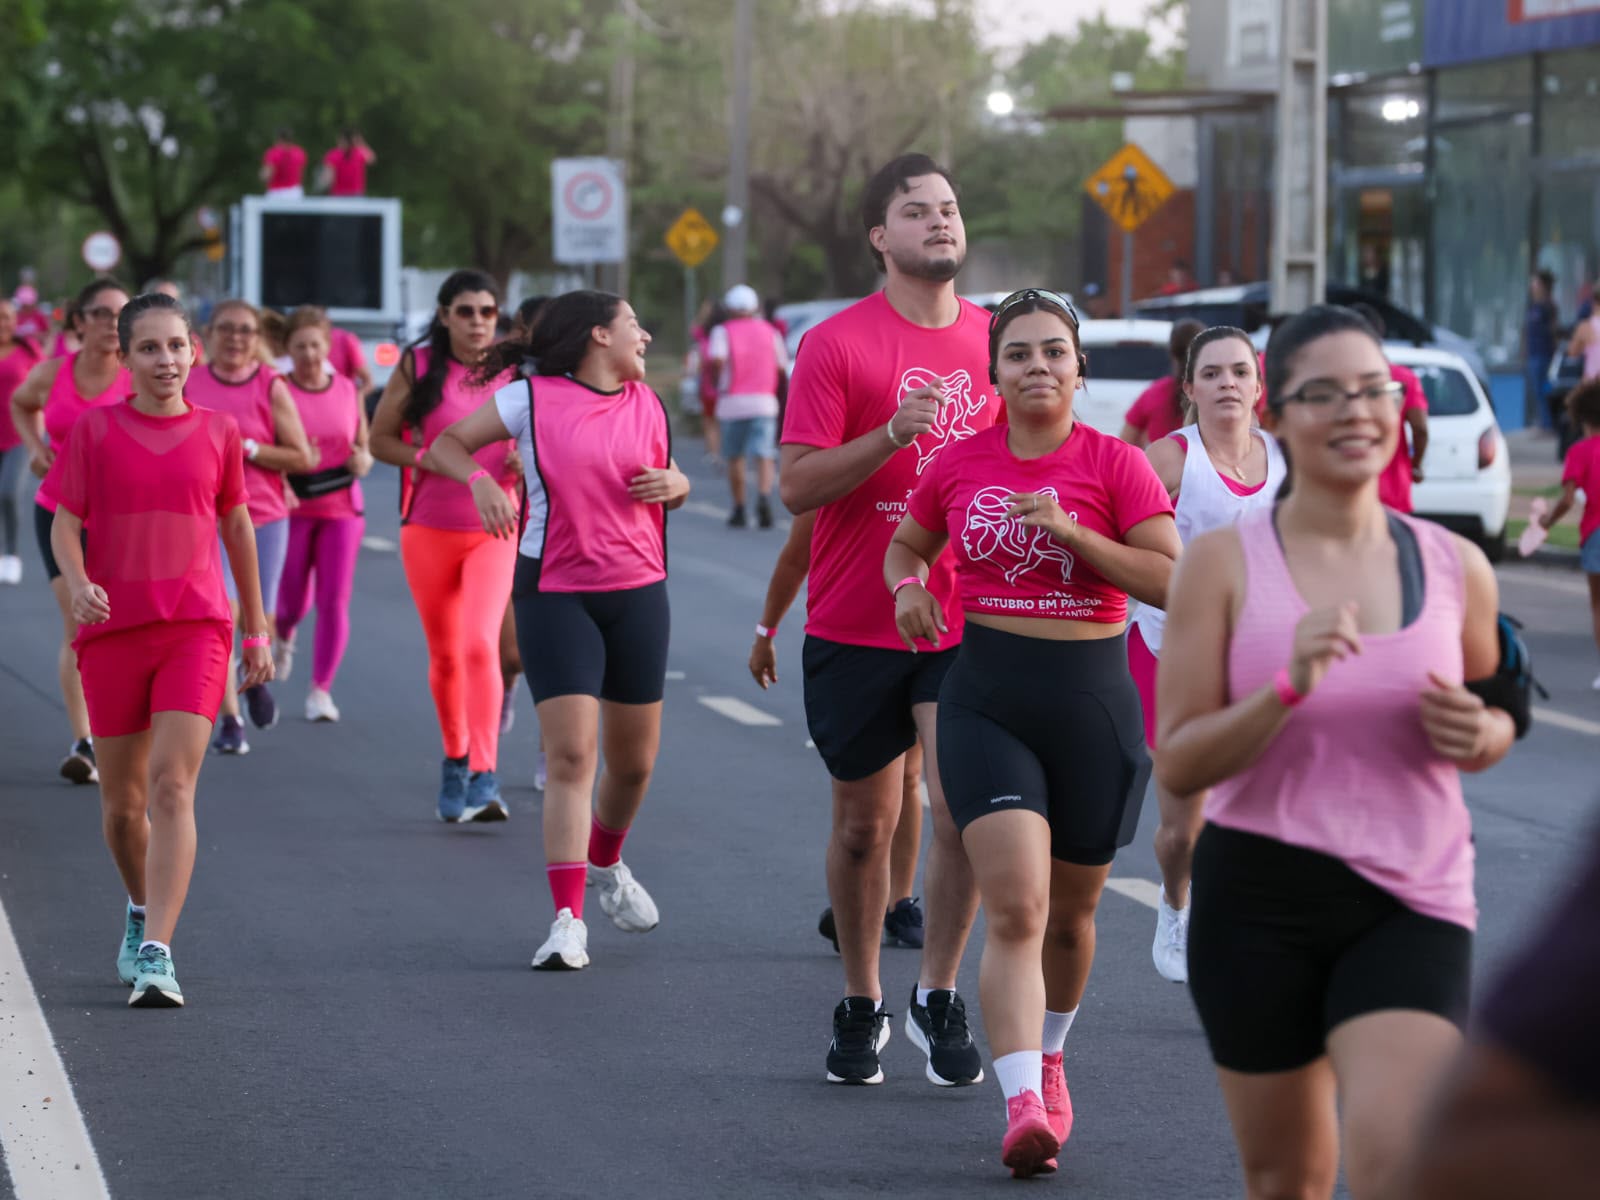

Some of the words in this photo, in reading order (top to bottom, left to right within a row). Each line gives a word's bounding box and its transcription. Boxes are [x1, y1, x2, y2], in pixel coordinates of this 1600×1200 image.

[876, 501, 908, 512] OUTU
[978, 597, 1034, 610] OUTUBRO
[1038, 599, 1057, 610] EM
